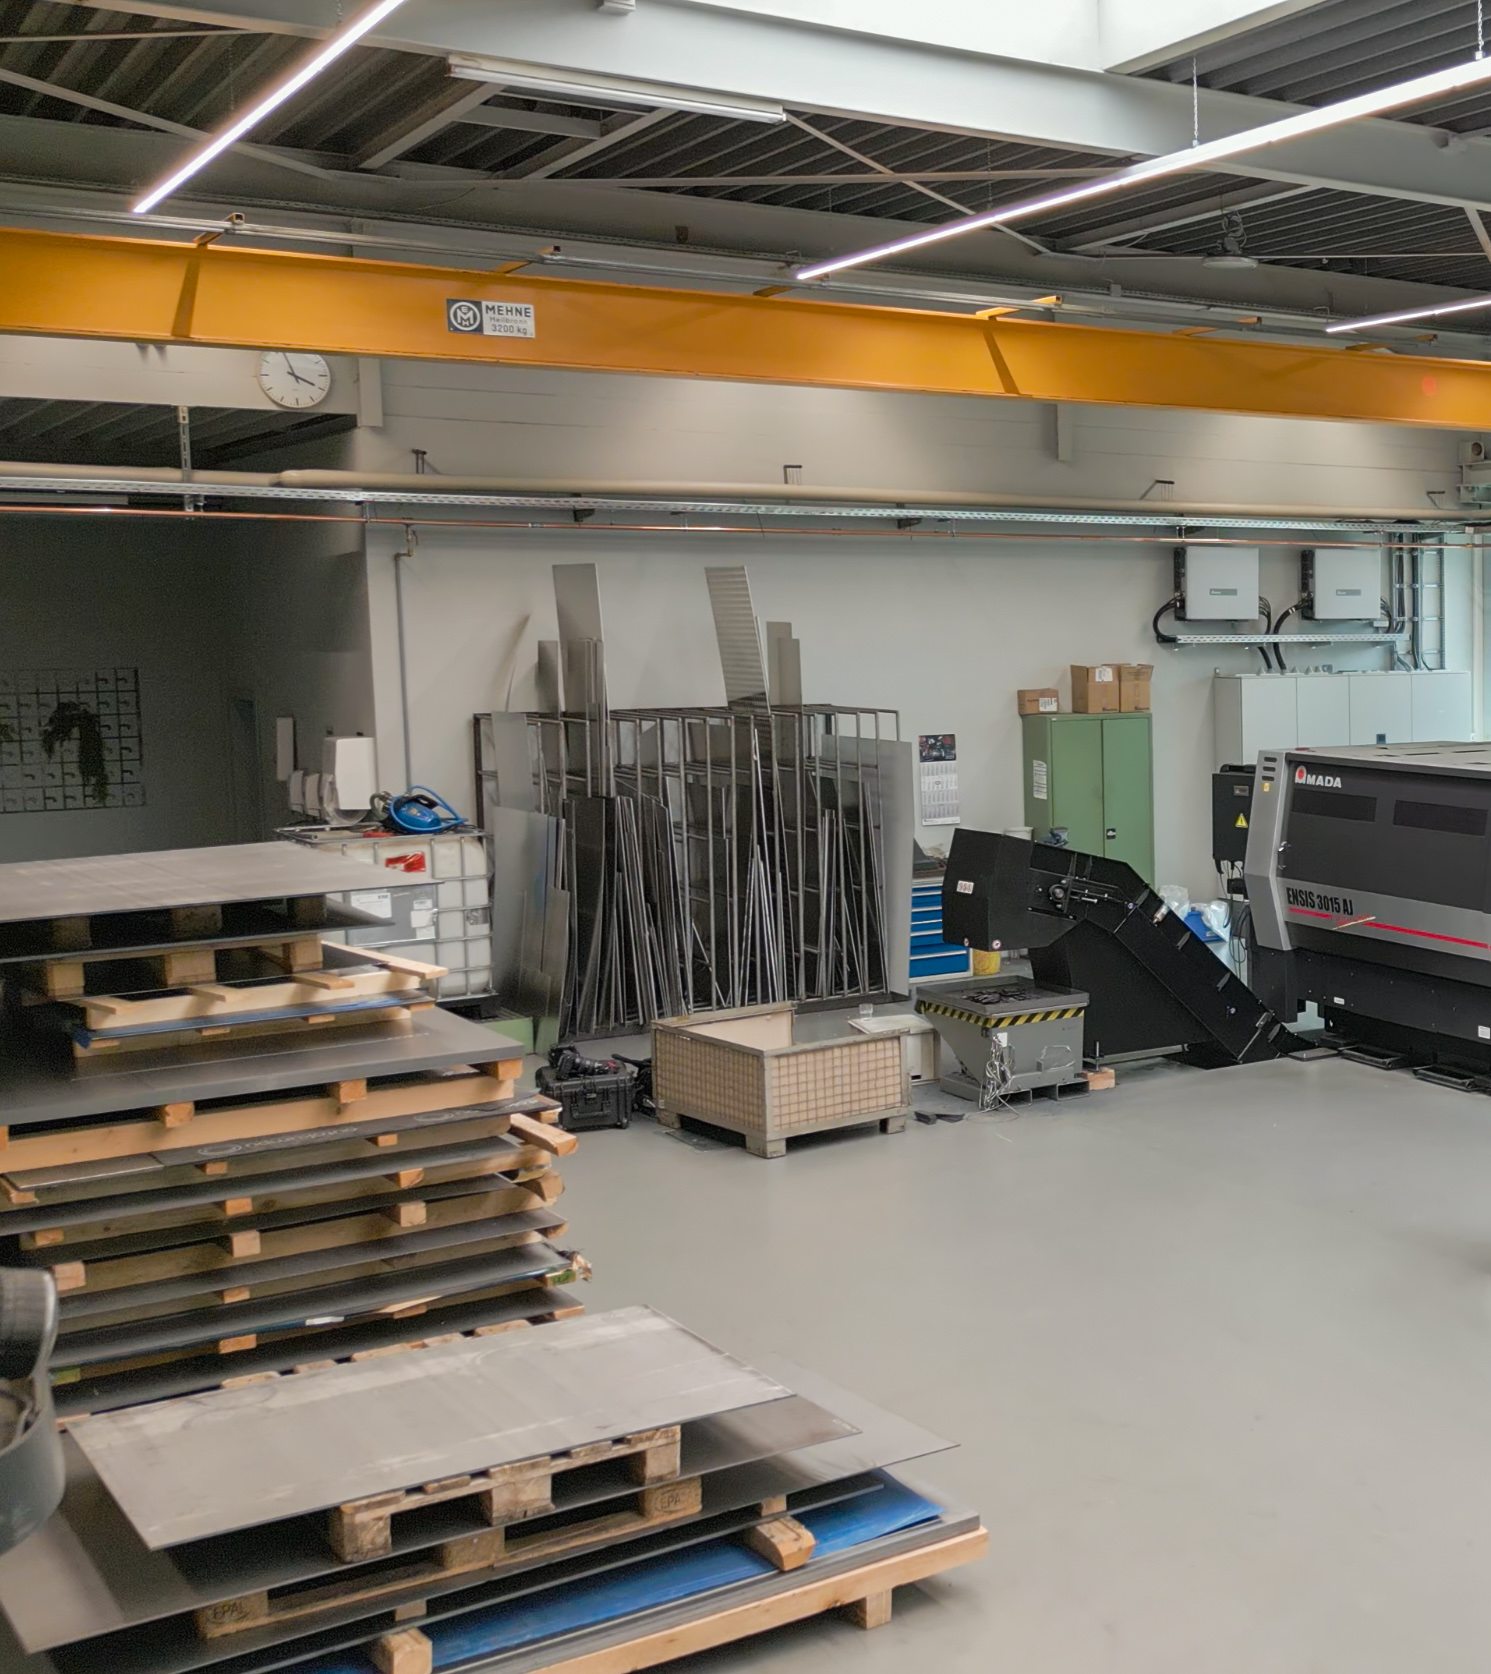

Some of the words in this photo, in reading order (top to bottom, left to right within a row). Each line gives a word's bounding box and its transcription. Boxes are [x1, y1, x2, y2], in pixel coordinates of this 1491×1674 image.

[485, 304, 531, 318] MEHNE
[491, 324, 515, 334] 3200
[517, 326, 528, 336] kg
[1295, 765, 1342, 789] AMADA
[1286, 887, 1316, 909] ENSIS
[1317, 894, 1341, 914] 3015
[1342, 898, 1354, 916] AJ
